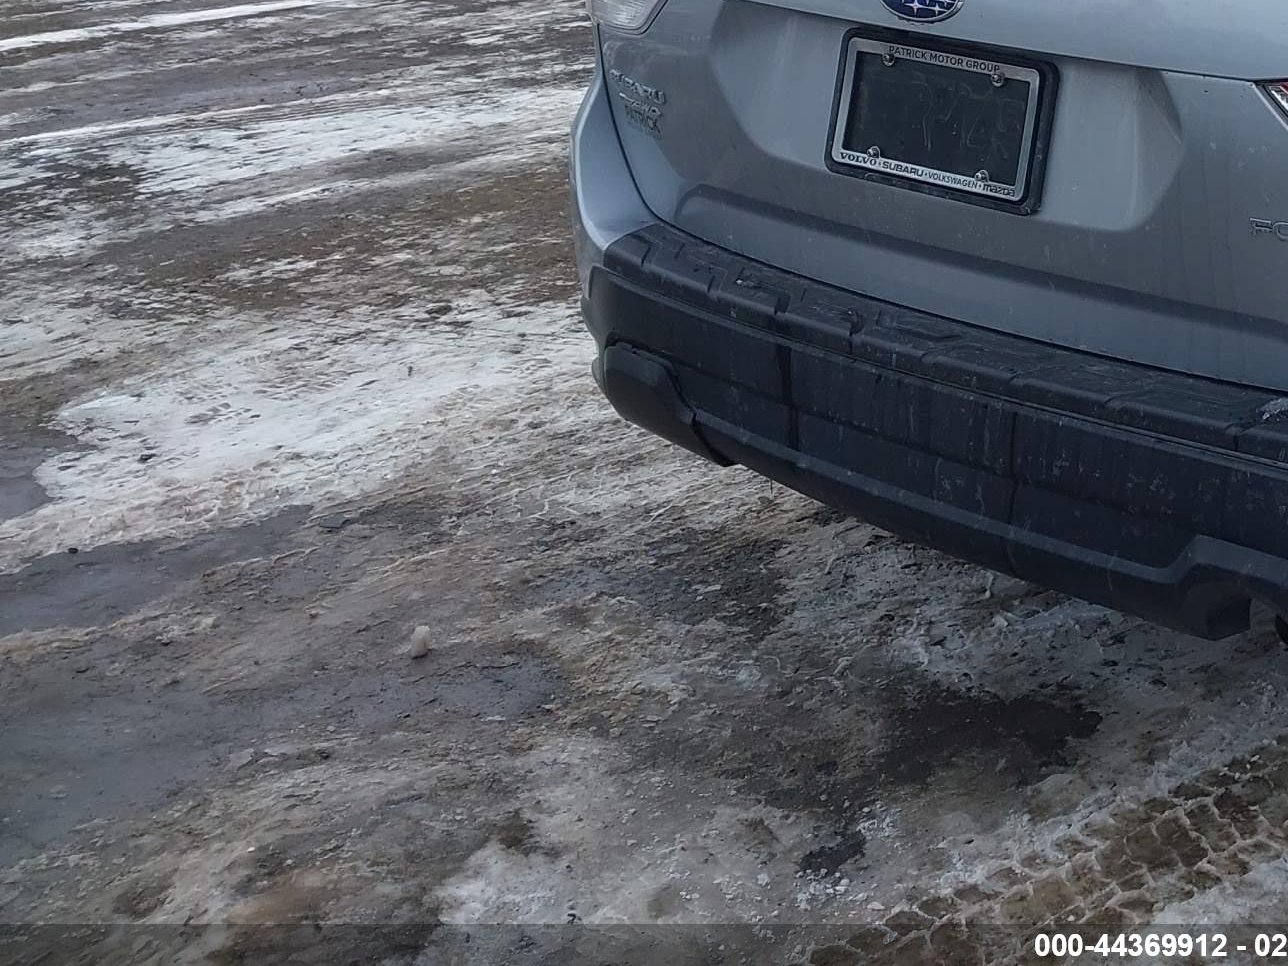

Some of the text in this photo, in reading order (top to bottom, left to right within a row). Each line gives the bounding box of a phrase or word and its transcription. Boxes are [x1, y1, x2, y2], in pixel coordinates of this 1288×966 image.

[888, 45, 1001, 73] PATRICK MOTOR GROUP
[839, 151, 877, 166] VOLVO
[881, 161, 925, 178] SUBARU
[928, 172, 978, 189] VOLKSWAGEN
